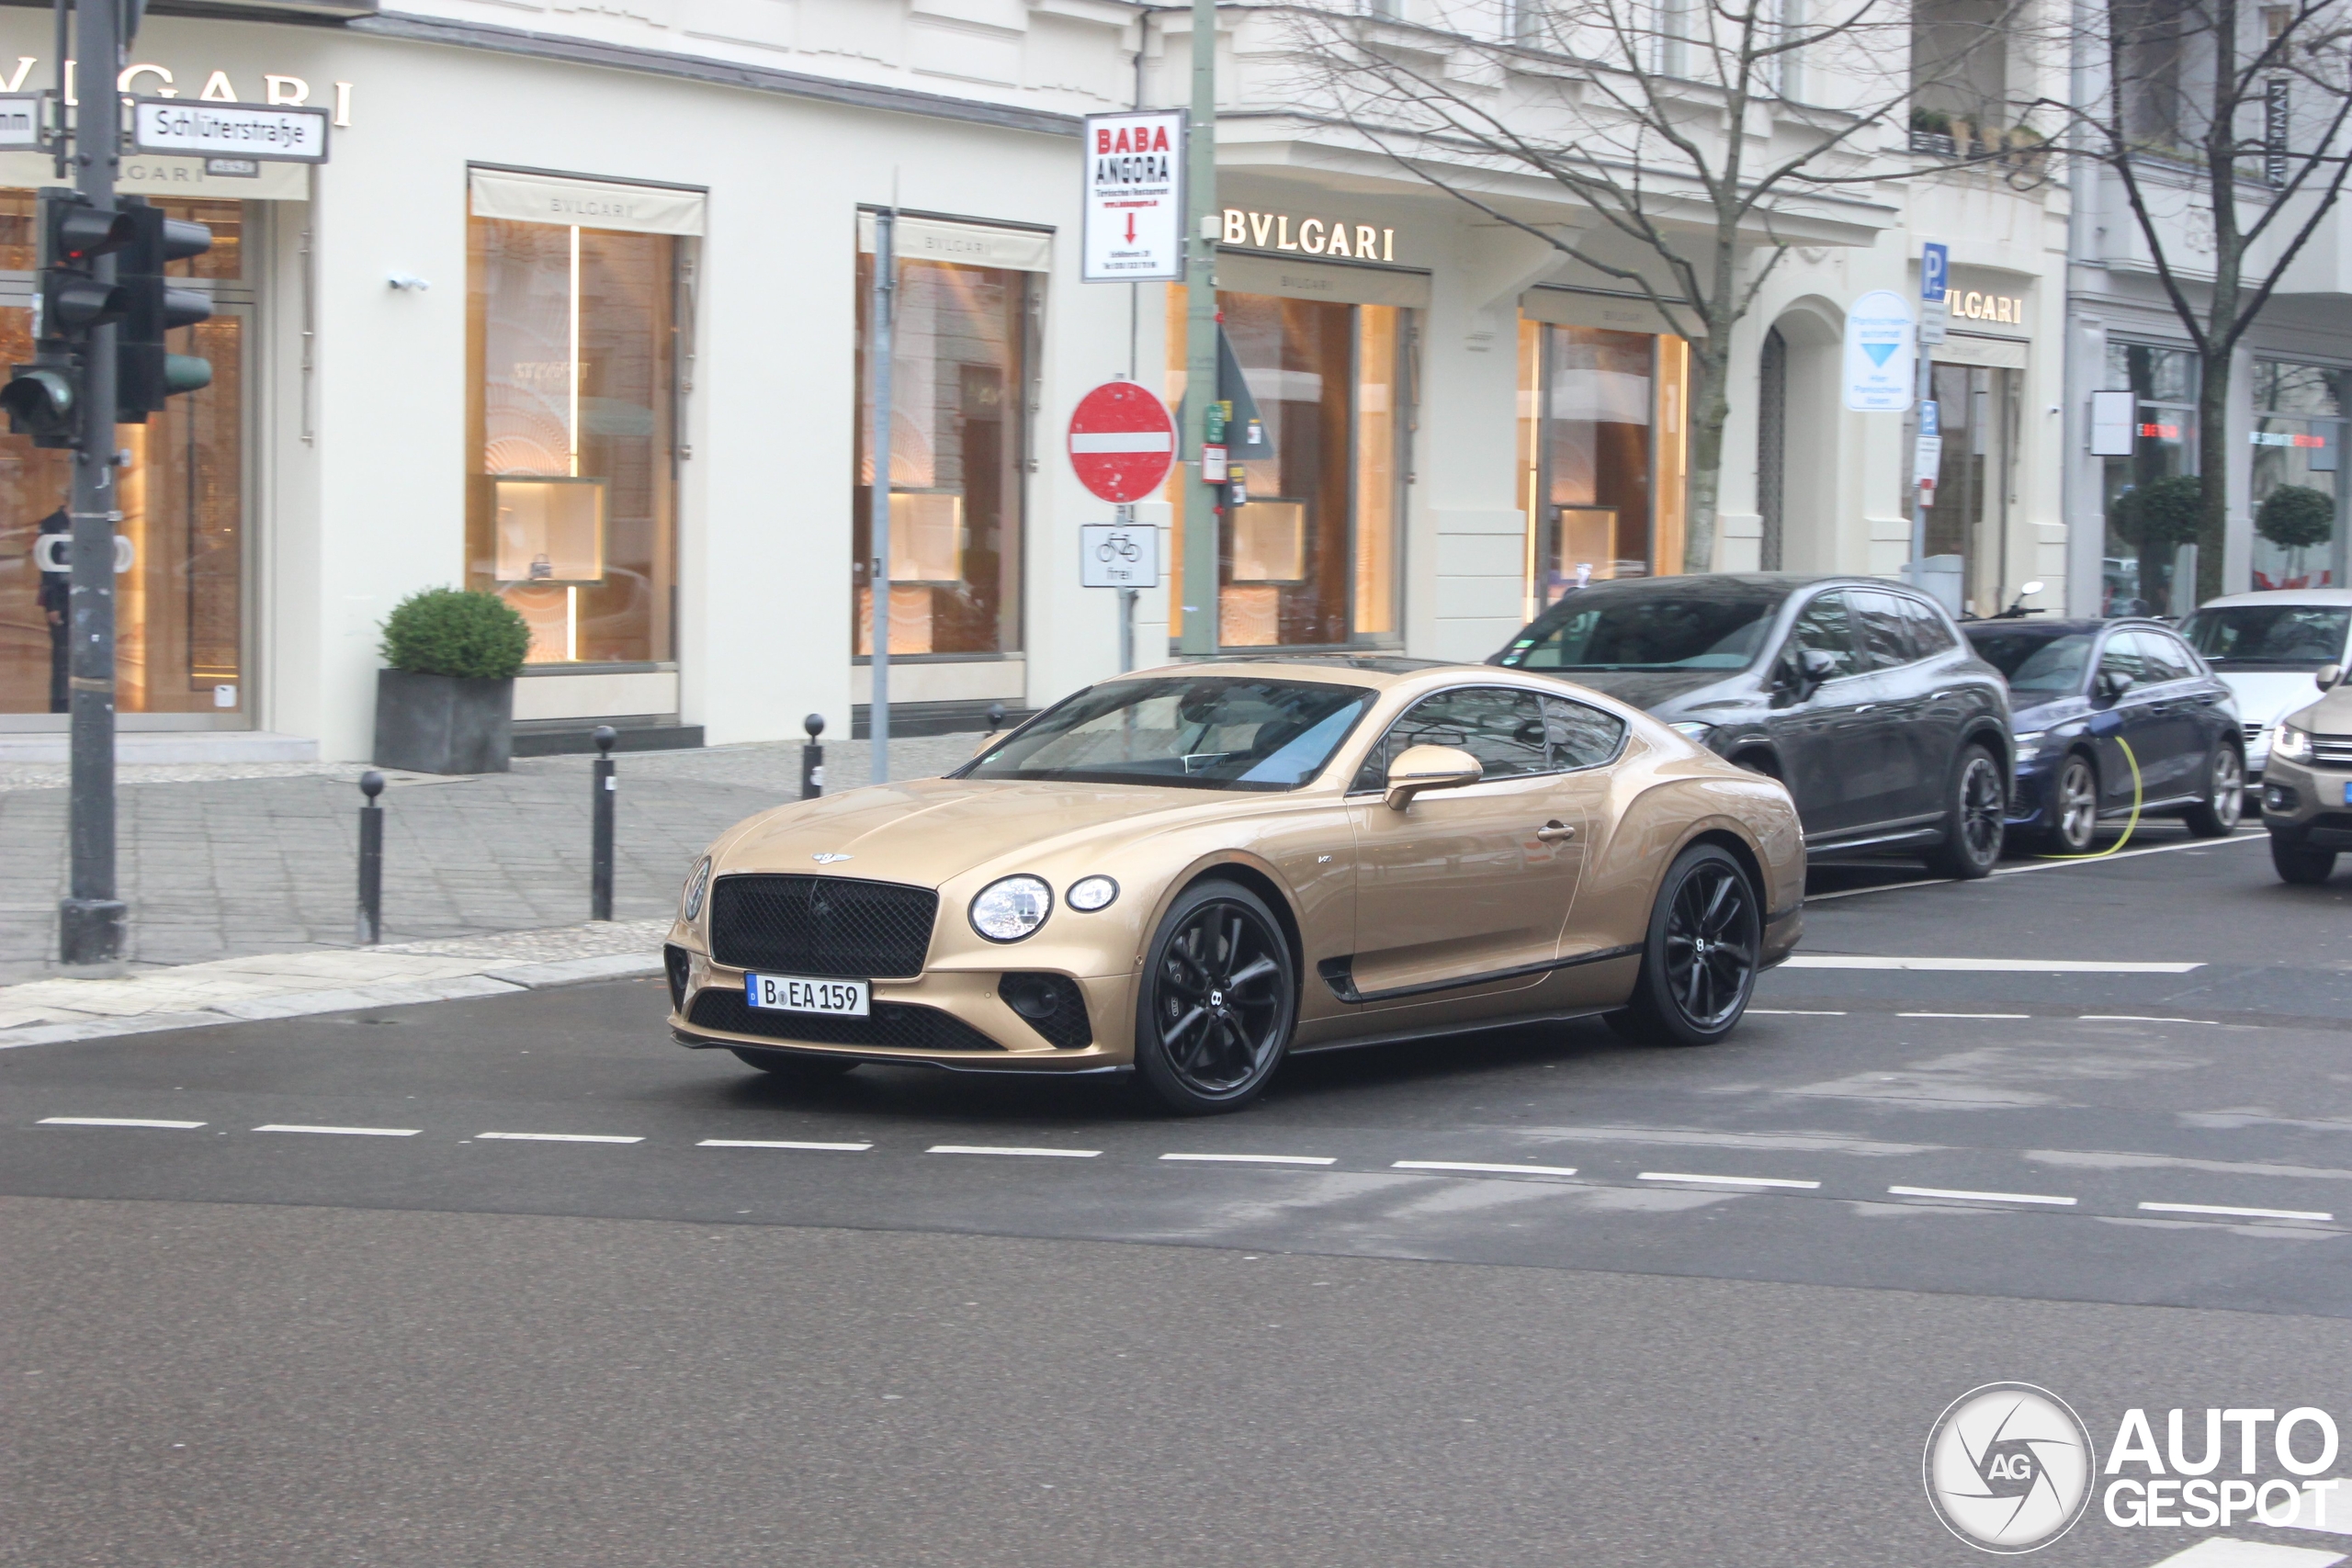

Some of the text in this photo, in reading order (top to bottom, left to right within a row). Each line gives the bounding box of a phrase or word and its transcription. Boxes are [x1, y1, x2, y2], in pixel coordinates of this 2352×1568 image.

[156, 109, 304, 147] Schlüterstraße
[1097, 126, 1170, 154] BABA
[1095, 155, 1170, 185] ANGORA
[551, 198, 633, 219] BVLGARI
[1222, 209, 1395, 262] BVLGARI
[1106, 567, 1133, 580] frei
[764, 979, 776, 1004] B
[788, 982, 815, 1009] EA
[819, 984, 858, 1010] 159
